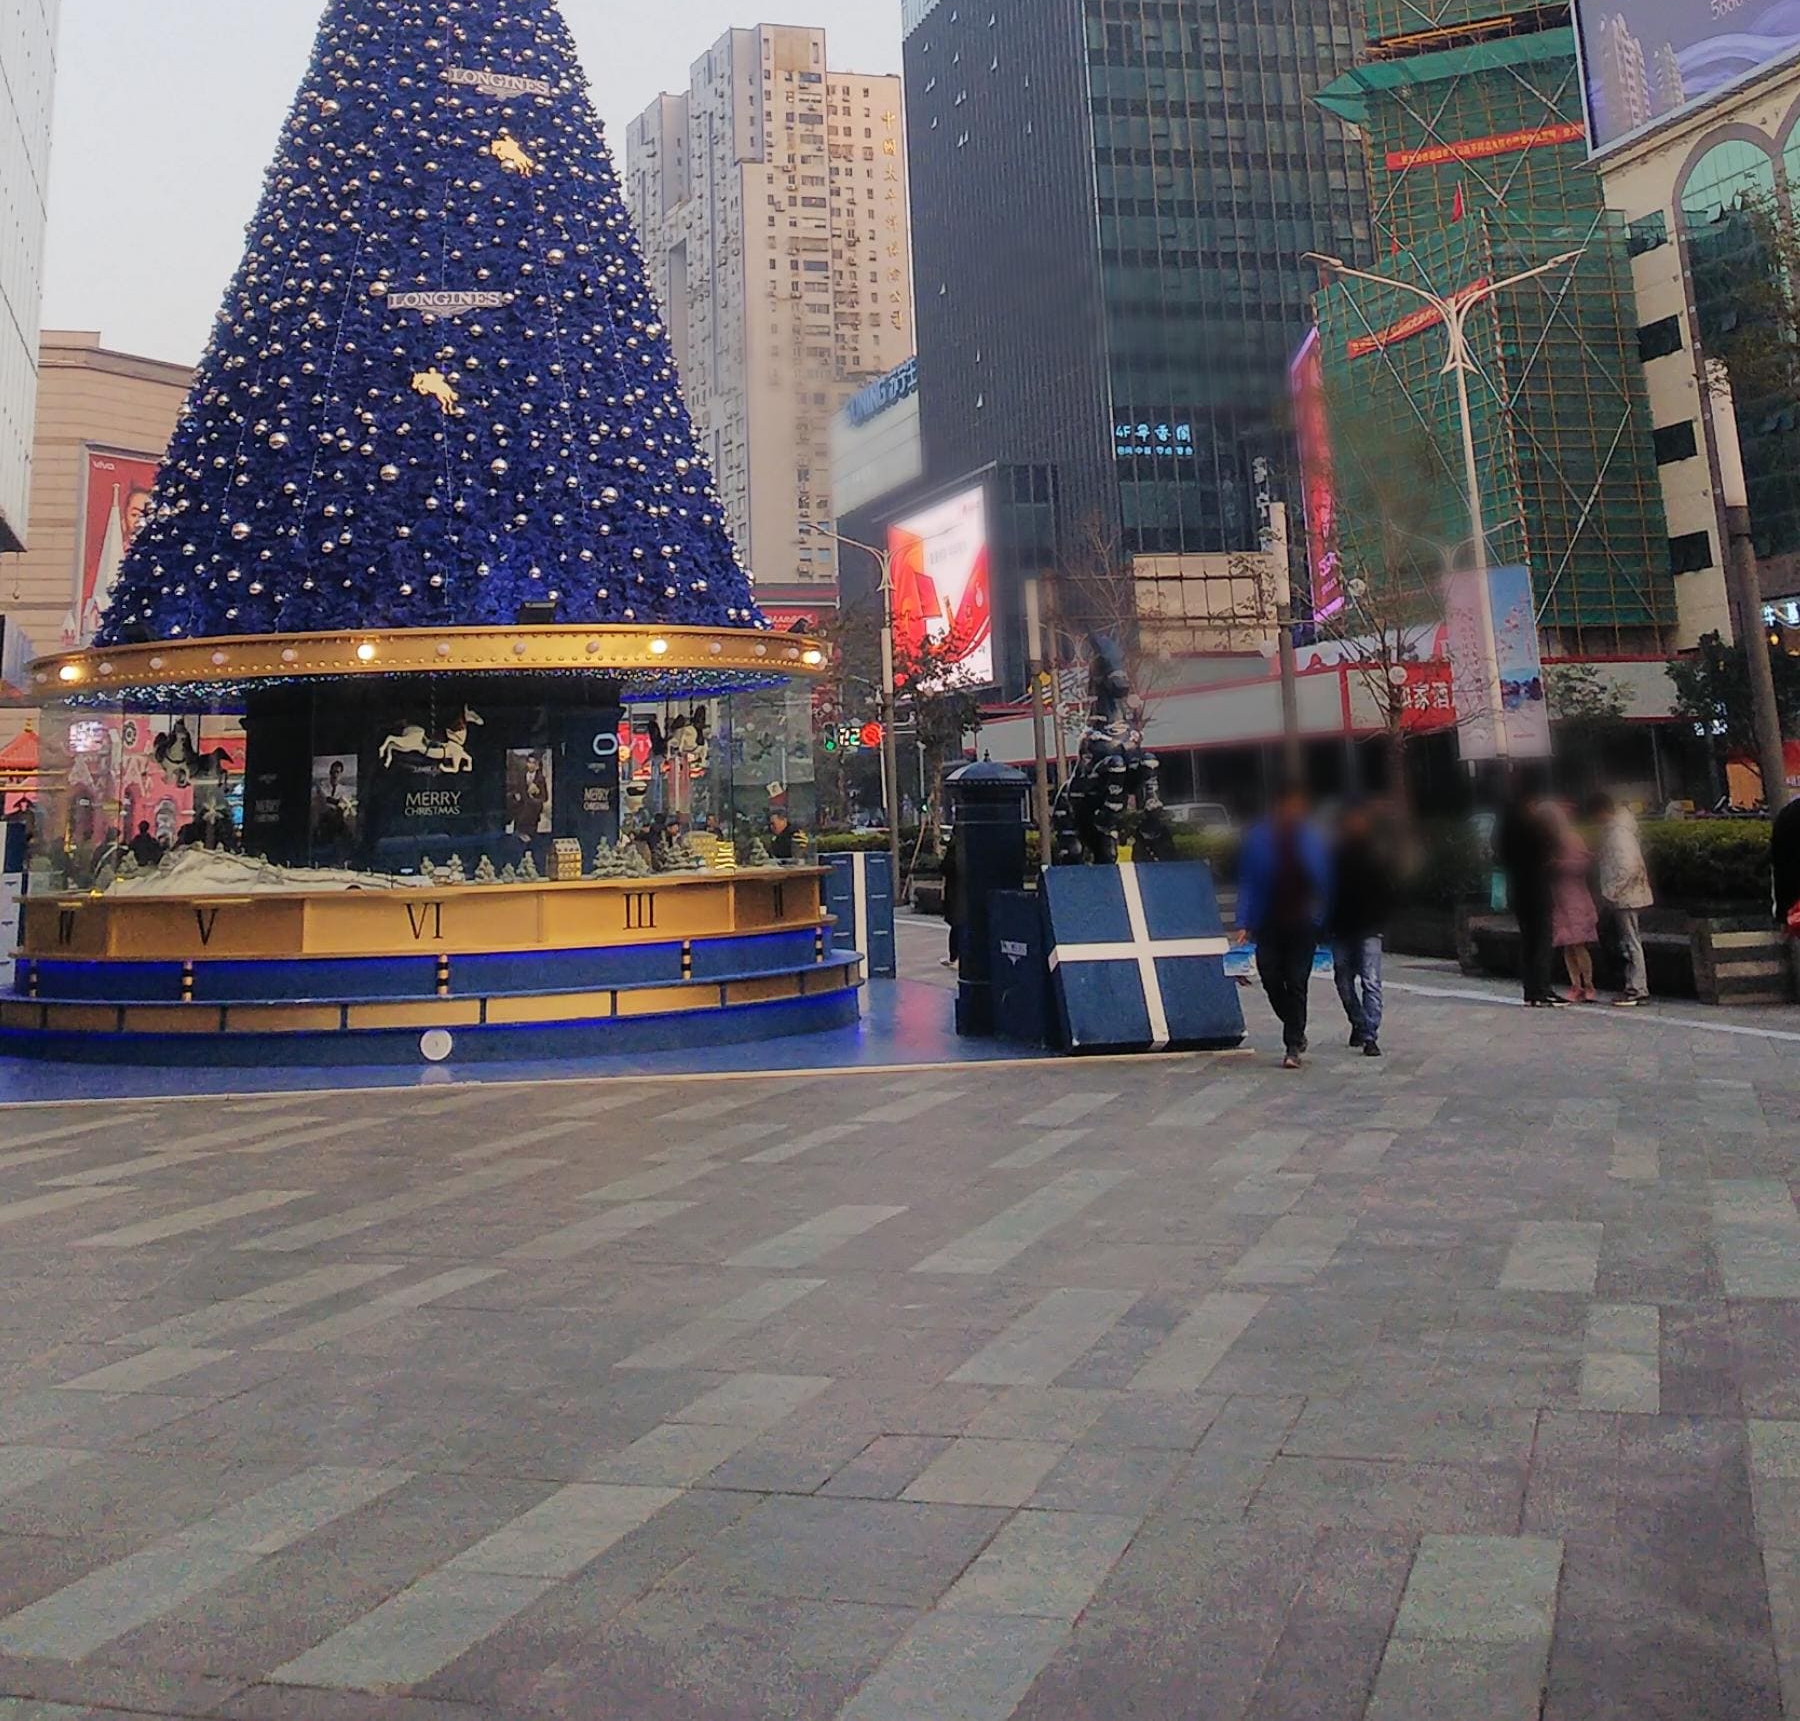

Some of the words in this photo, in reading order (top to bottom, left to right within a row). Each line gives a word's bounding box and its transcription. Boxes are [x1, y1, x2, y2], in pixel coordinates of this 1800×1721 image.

[452, 69, 546, 93] LONGINES
[389, 291, 500, 306] LONGINES
[406, 790, 461, 806] MERRY
[404, 806, 460, 816] CHRISTMAS
[405, 902, 443, 940] VI
[623, 892, 656, 930] III
[196, 908, 221, 946] V
